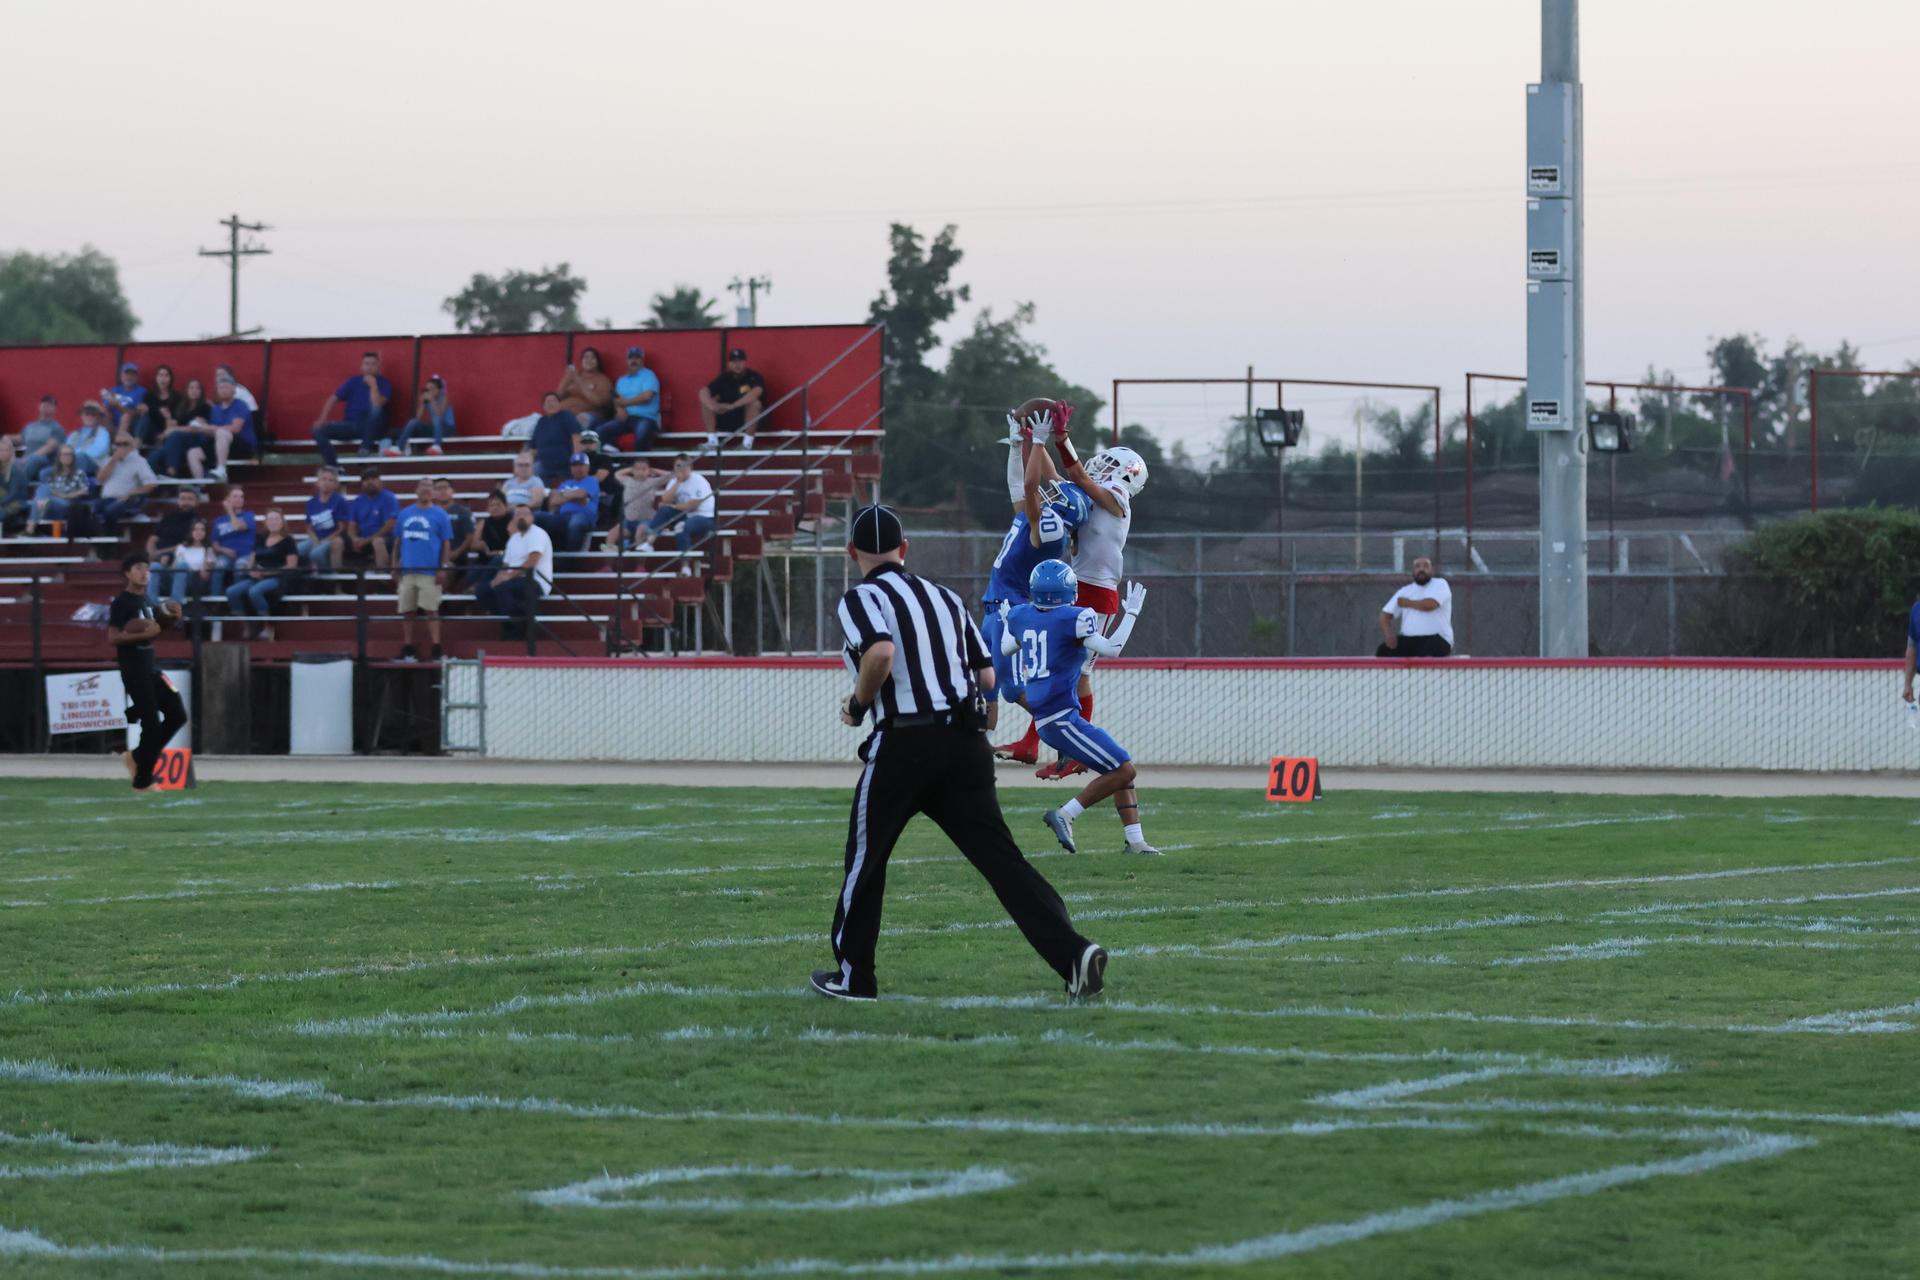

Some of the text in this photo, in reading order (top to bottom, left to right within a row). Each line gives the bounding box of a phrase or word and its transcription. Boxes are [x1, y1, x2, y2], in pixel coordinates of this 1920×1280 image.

[1022, 629, 1051, 678] 31
[152, 751, 184, 784] 20
[1270, 760, 1310, 797] 10
